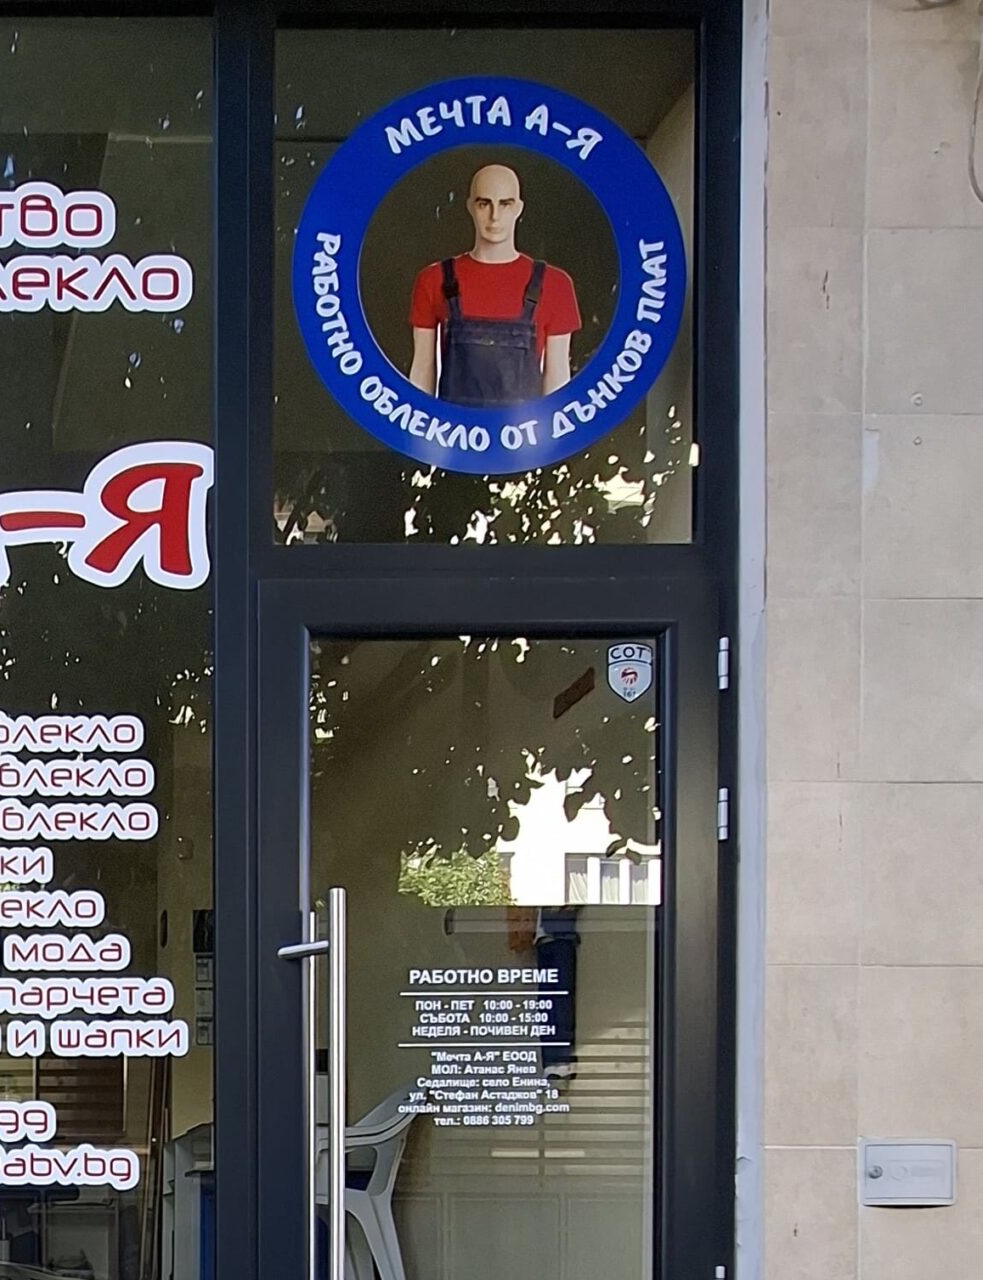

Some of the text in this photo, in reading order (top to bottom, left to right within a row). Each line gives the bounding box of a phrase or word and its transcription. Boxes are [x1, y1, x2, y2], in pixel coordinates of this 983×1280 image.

[384, 95, 604, 160] МЕЧТА А-Я
[312, 232, 669, 452] РАБОТНО ОБЛЕКЛО ОТ ДЪНКОВ ПЛАТ
[11, 943, 123, 963] мода
[409, 968, 559, 985] РАБОТНО ВРЕМЕ
[415, 1000, 441, 1011] ПОН
[451, 1000, 475, 1011] ПЕТ
[482, 1000, 513, 1010] 10:00
[523, 999, 553, 1010] 19:00
[419, 1013, 471, 1023] СЪБОТА
[479, 1013, 509, 1023] 10:00
[518, 1012, 548, 1023] 15:00
[412, 1026, 461, 1037] НЕДЕЛЯ
[470, 1026, 528, 1036] ПОЧИВЕН
[530, 1025, 556, 1037] ДЕН
[16, 1028, 38, 1049] и
[58, 1028, 181, 1049] шапки
[502, 1051, 537, 1062] ЕООД
[431, 1064, 462, 1075] МОЛ:
[463, 1064, 505, 1074] Атанас
[416, 1077, 480, 1088] Седалище:
[482, 1078, 510, 1087] село
[408, 1091, 427, 1102] ул.
[545, 1089, 559, 1099] 18
[398, 1102, 570, 1114] онлайн магазин: denimbg.com
[463, 1115, 489, 1125] 0886
[491, 1115, 512, 1125] 305
[514, 1115, 534, 1125] 799
